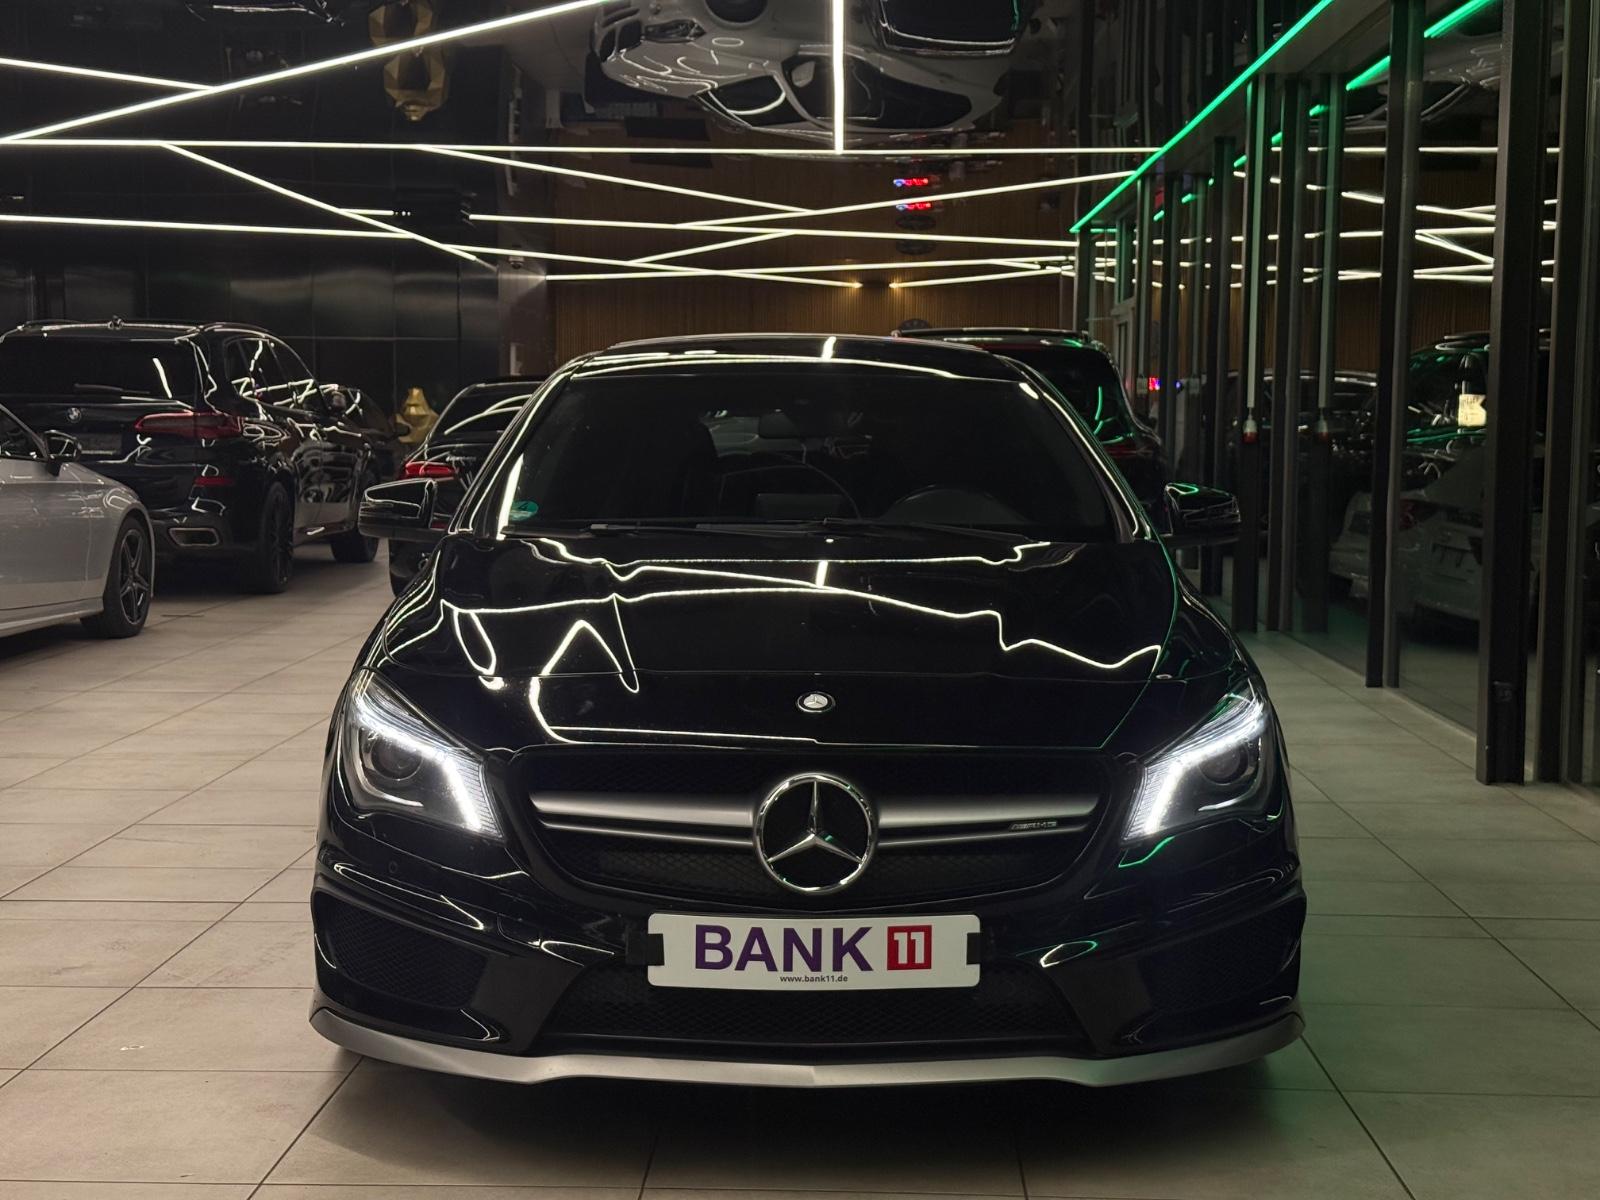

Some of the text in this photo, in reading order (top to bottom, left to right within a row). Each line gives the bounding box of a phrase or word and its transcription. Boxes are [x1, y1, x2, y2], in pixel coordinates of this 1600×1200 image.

[695, 924, 927, 972] BANK 11
[780, 974, 848, 983] www.bank11.de
